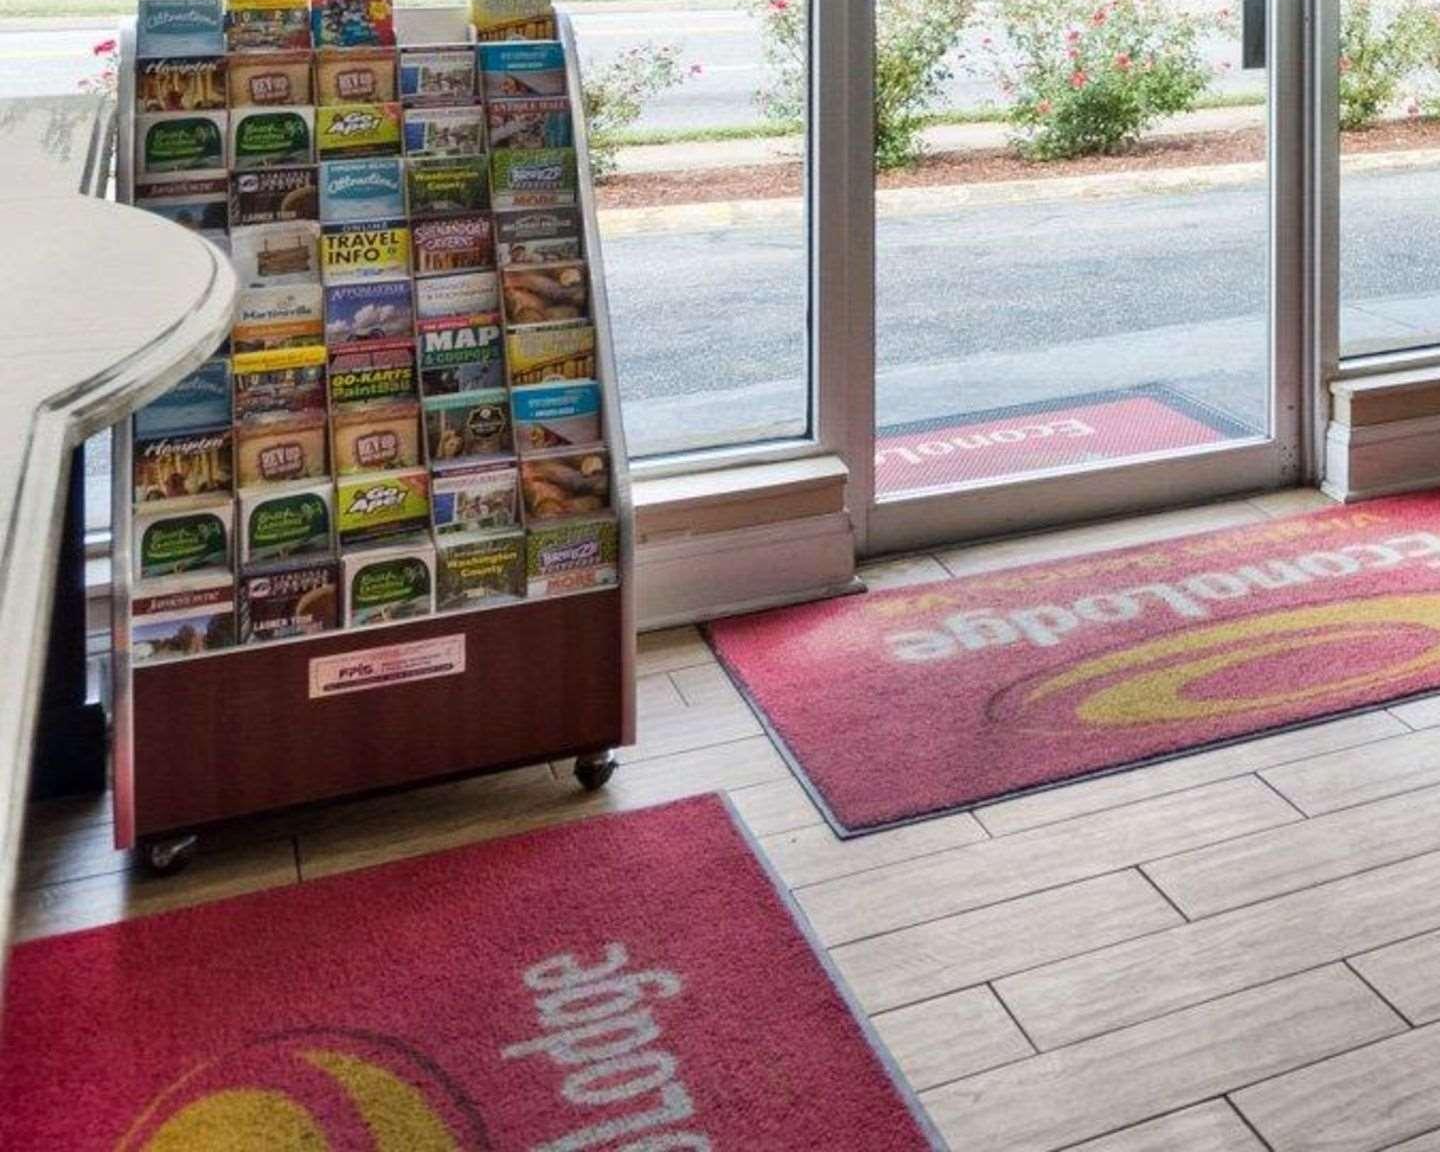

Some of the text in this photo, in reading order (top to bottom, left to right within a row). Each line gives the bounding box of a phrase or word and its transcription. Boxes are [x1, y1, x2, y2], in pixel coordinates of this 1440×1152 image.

[326, 231, 401, 250] TRAVEL
[327, 249, 381, 265] INFO
[425, 325, 500, 352] MAP
